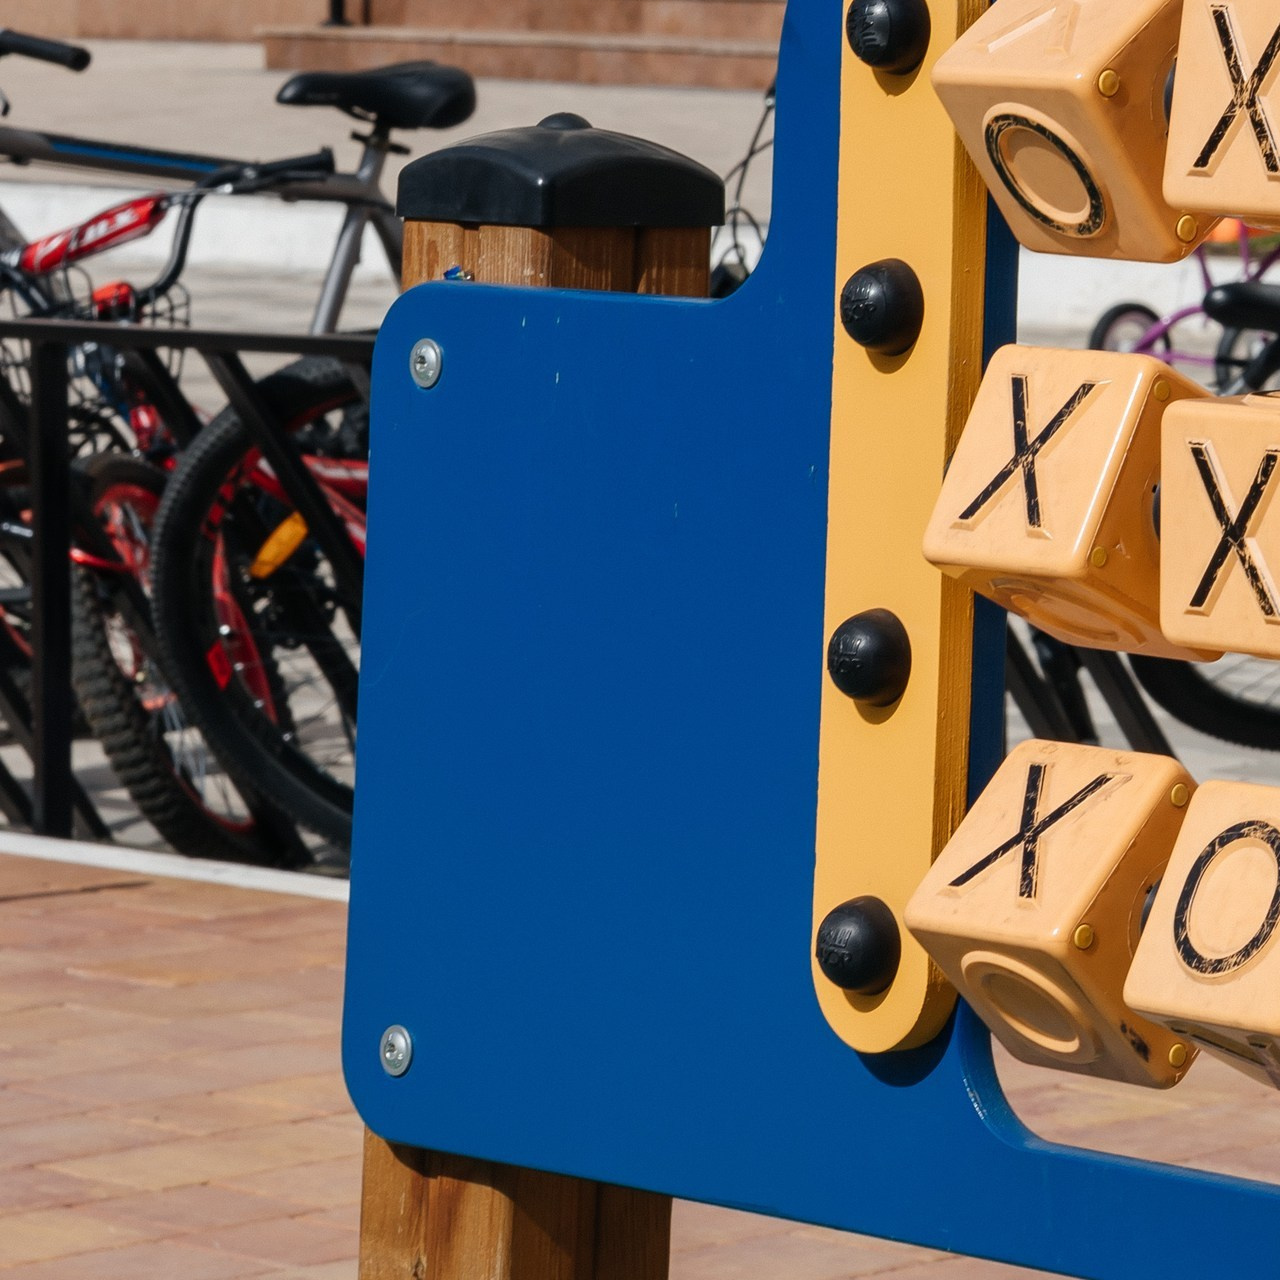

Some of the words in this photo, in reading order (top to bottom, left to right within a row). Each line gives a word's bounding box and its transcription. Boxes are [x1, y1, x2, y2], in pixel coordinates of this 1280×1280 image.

[983, 111, 1106, 238] O
[957, 374, 1100, 529] X
[948, 763, 1114, 899] X
